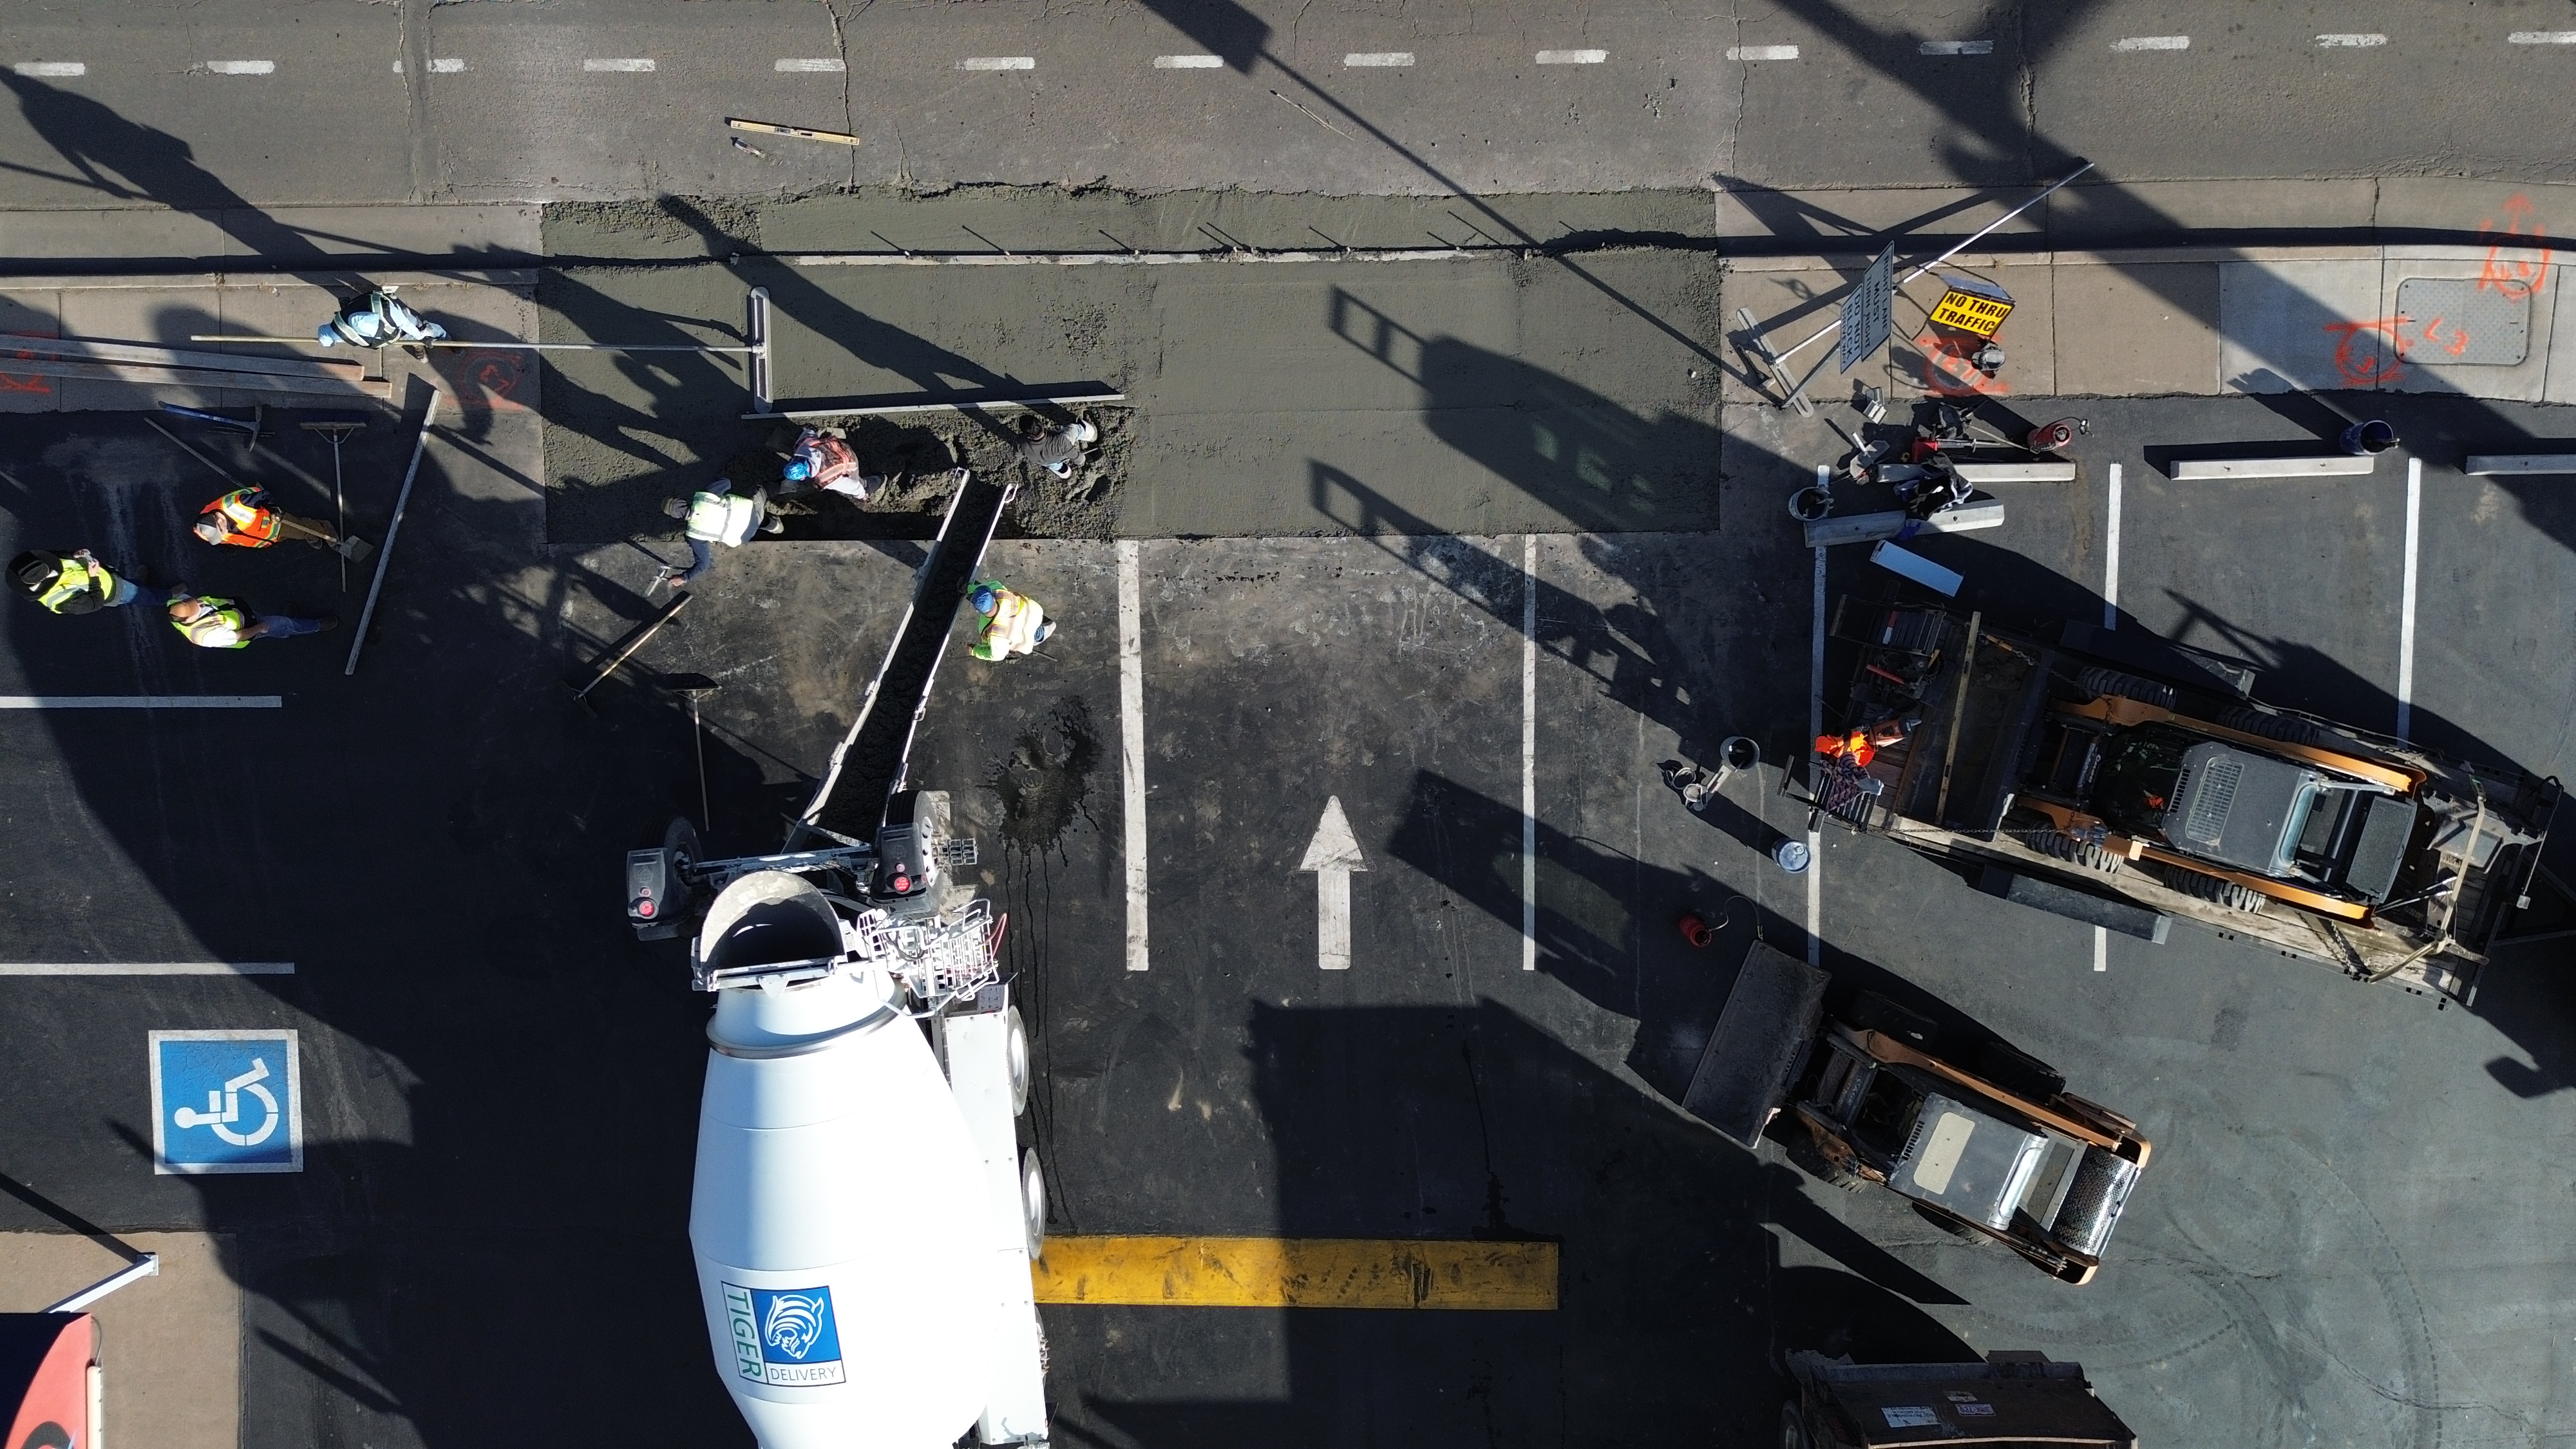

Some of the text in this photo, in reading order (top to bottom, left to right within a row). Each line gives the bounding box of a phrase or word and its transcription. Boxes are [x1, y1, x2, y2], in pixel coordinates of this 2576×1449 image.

[1854, 294, 1861, 316] DO
[1945, 293, 2009, 318] NO THRU
[1938, 308, 1996, 332] TRAFFIC
[727, 1291, 762, 1377] TIGER
[770, 1366, 837, 1381] DELIVERY
